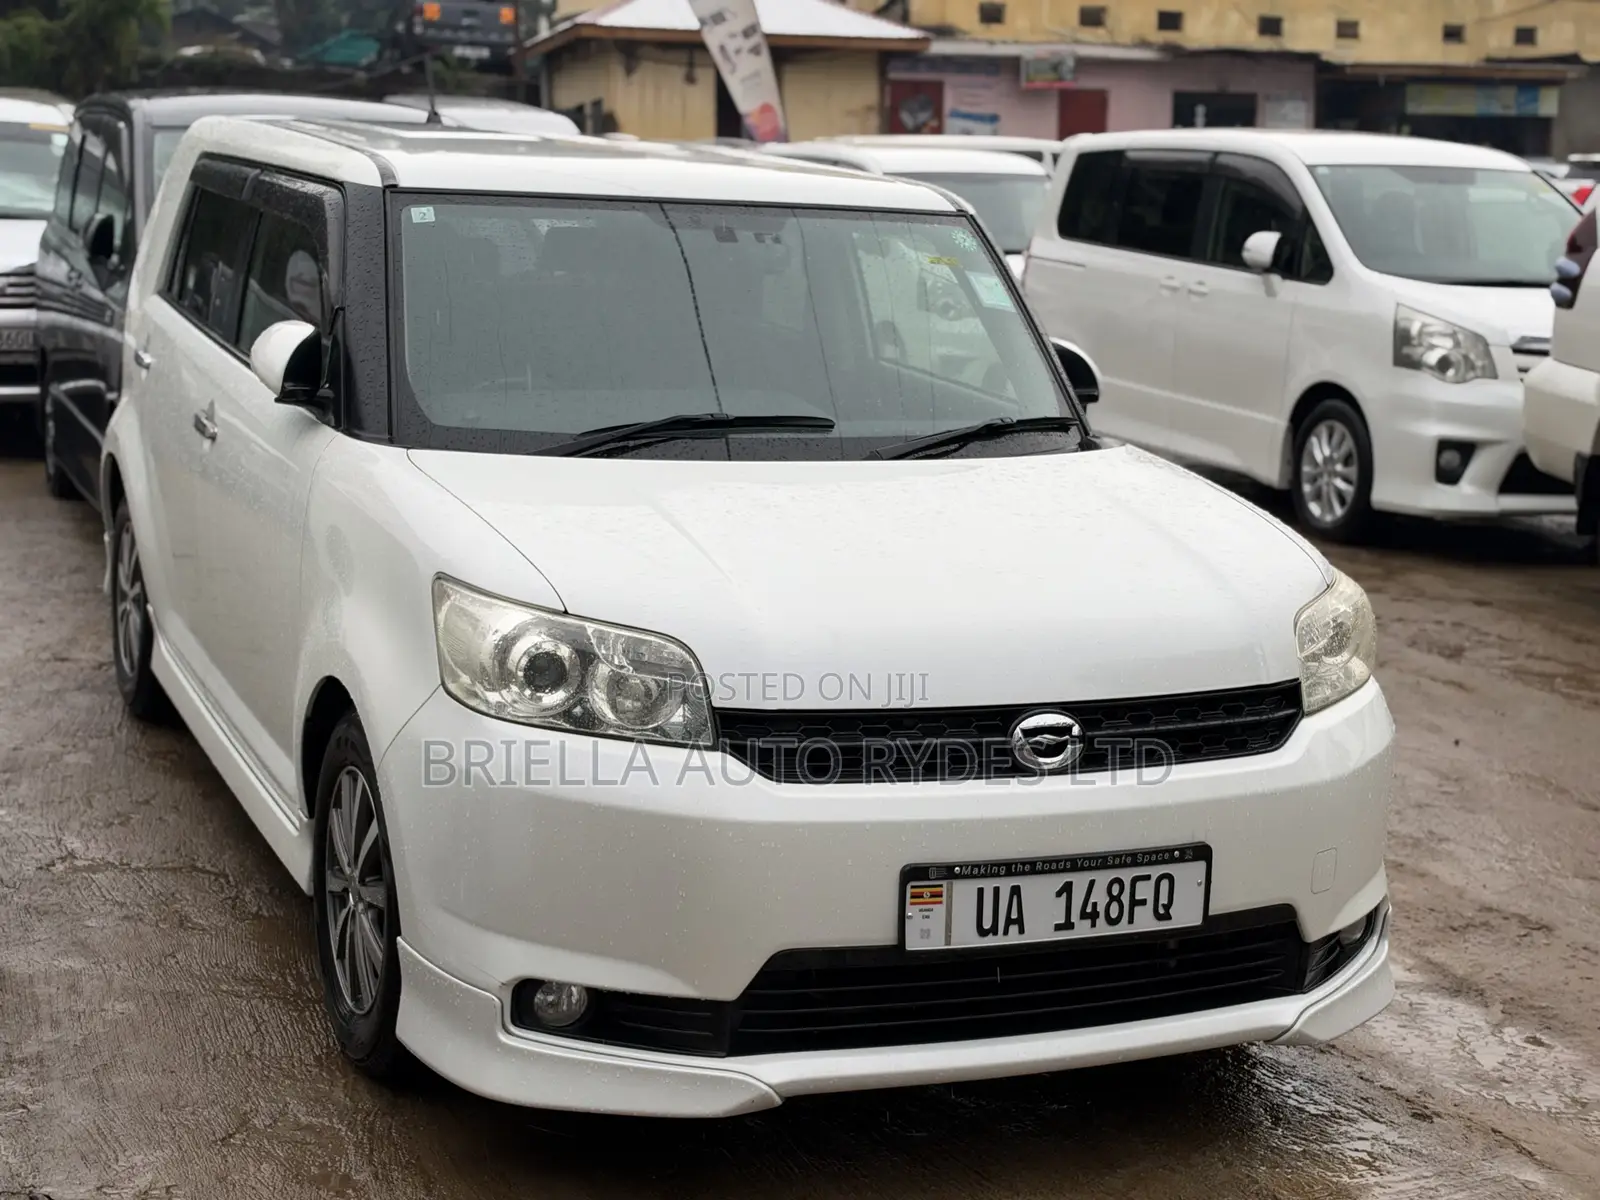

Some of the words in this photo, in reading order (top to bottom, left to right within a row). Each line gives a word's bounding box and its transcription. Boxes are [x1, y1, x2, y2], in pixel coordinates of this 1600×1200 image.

[961, 864, 1006, 876] Making
[1012, 862, 1030, 872] the
[1036, 859, 1071, 871] Roads
[1077, 857, 1102, 868] Your
[1107, 853, 1132, 866] Safe
[1137, 852, 1170, 864] Space
[976, 884, 1025, 938] UA
[1054, 872, 1175, 932] 148FQ
